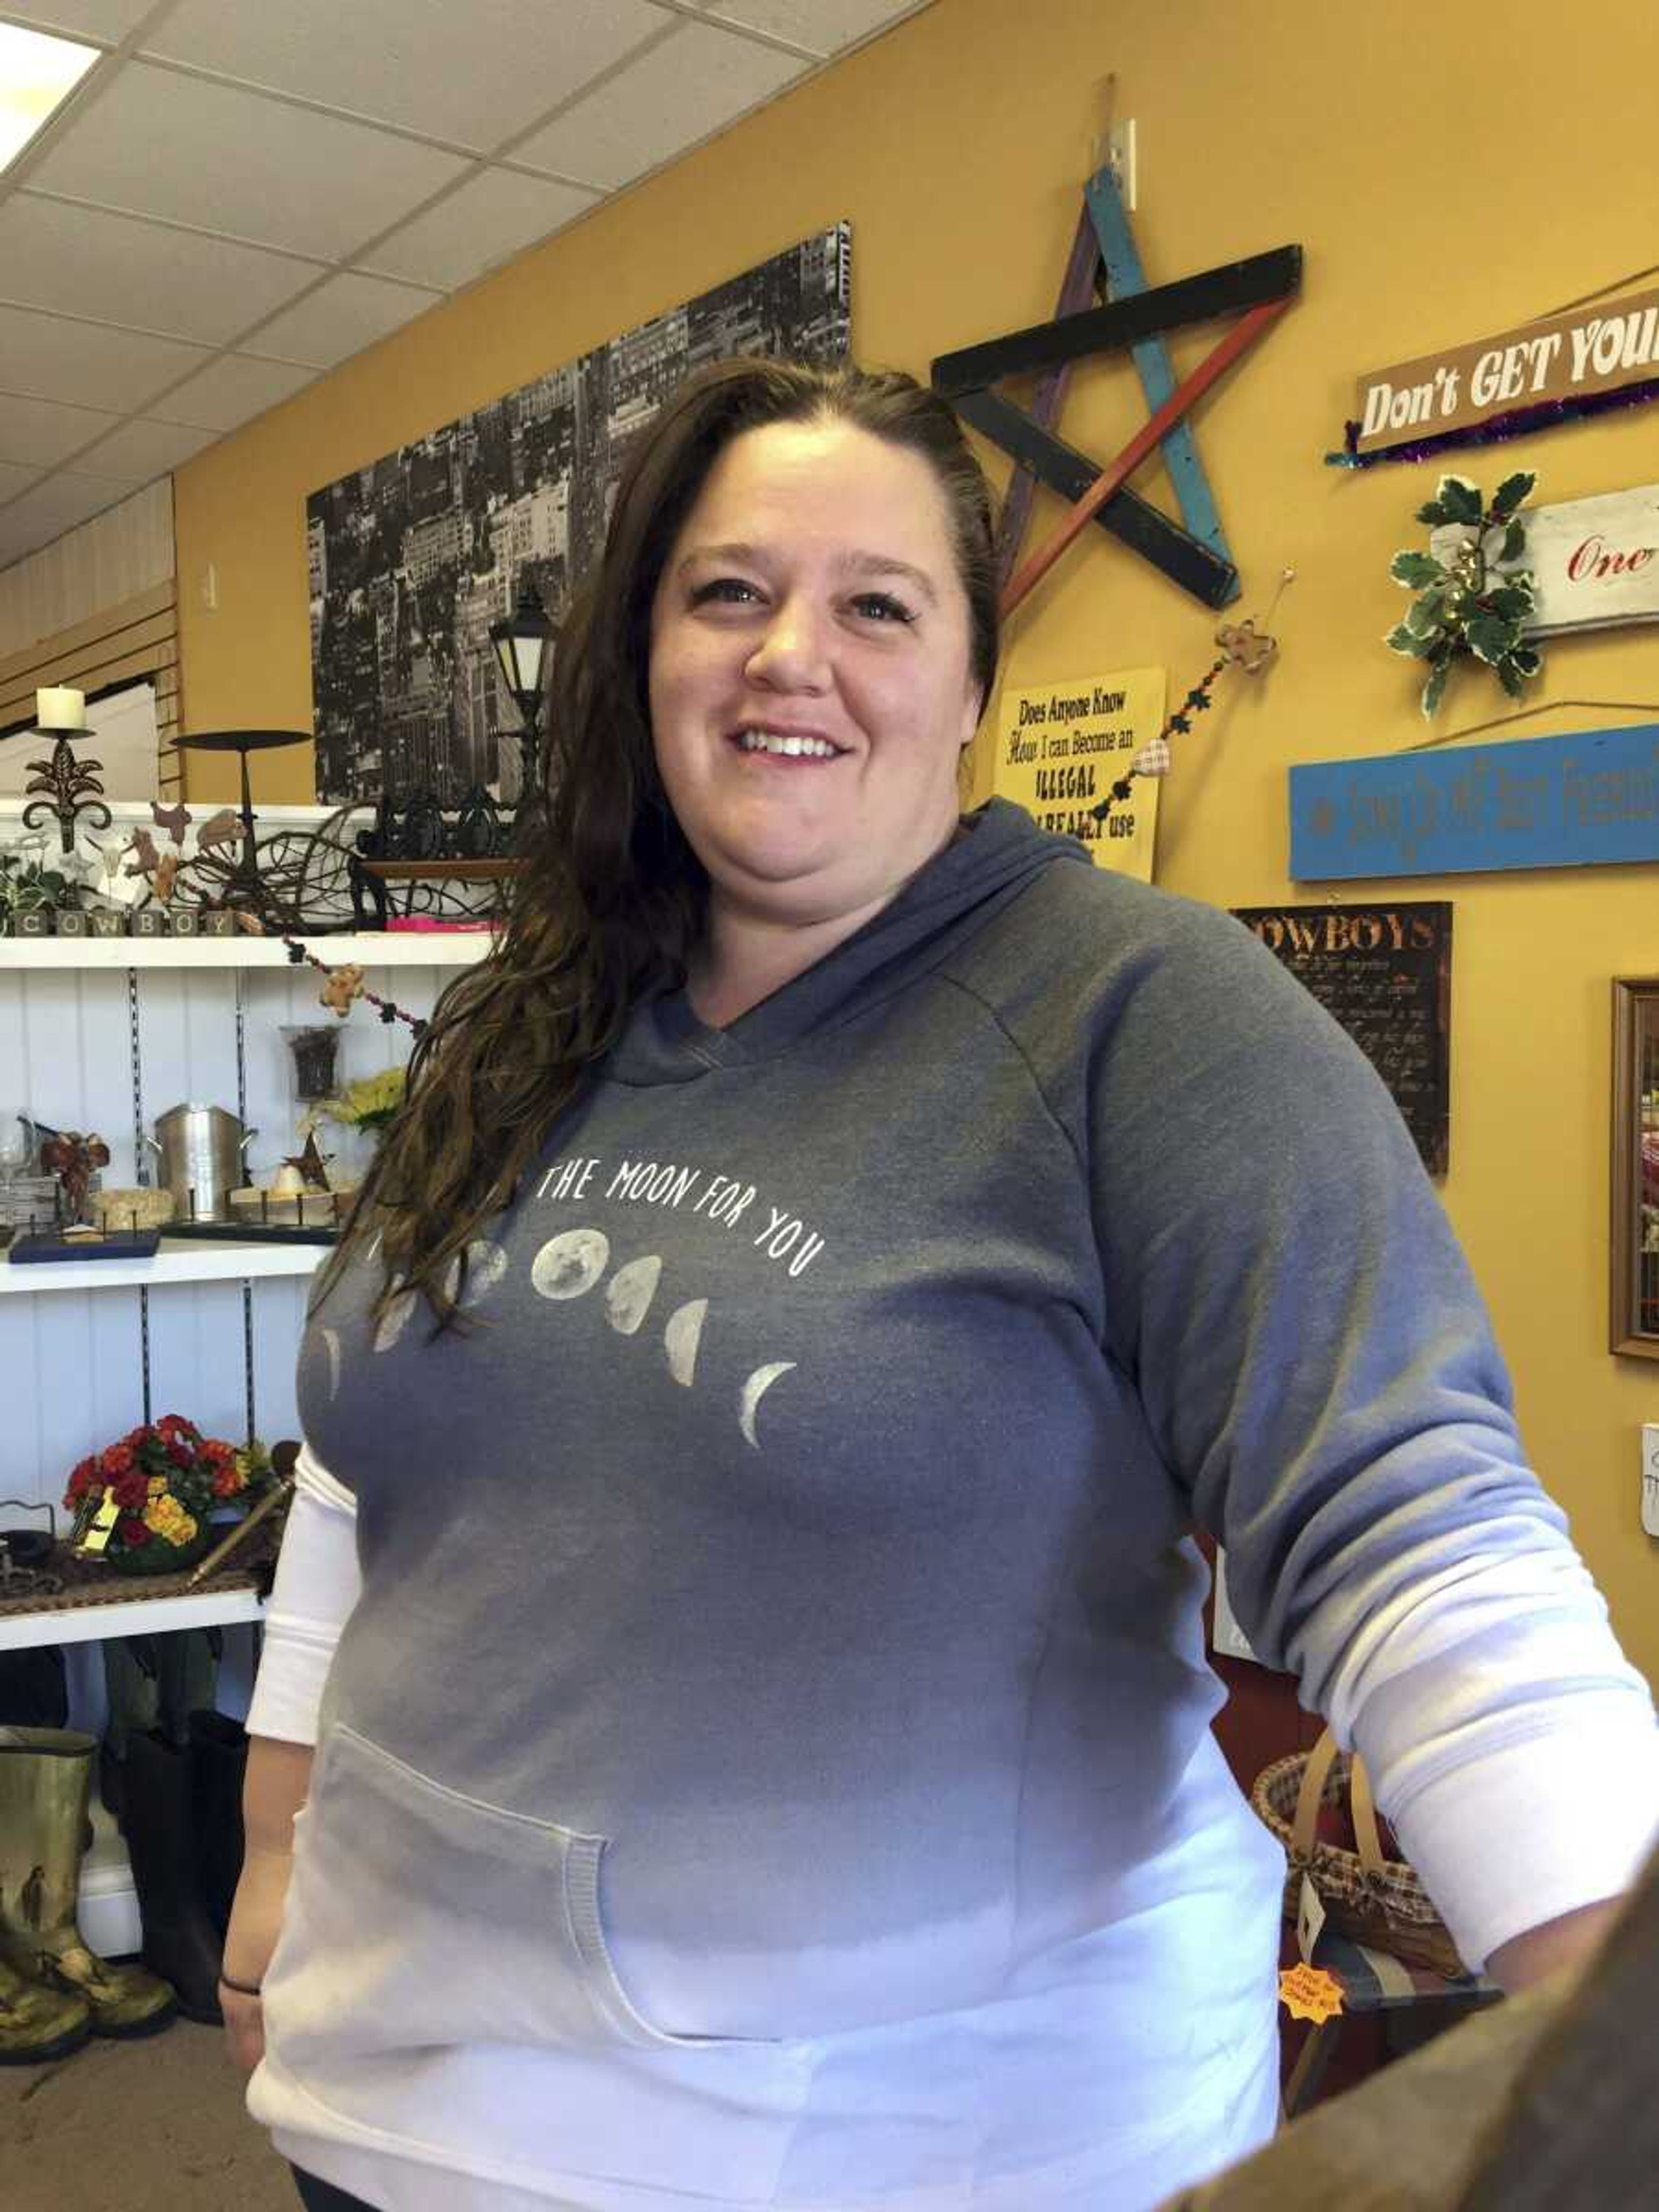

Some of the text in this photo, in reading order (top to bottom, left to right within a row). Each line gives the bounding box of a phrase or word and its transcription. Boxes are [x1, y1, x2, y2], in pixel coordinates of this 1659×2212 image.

[1361, 307, 1659, 438] Don't GET YOU
[1568, 534, 1653, 583] One
[1019, 687, 1126, 726] Does Anyone Know
[1006, 729, 1133, 765] How I can Become an
[1036, 765, 1096, 800] ILLEGAL
[1109, 814, 1135, 838] use
[1252, 913, 1434, 953] OWBOYS
[536, 1157, 826, 1278] THE MOON FOR YOU
